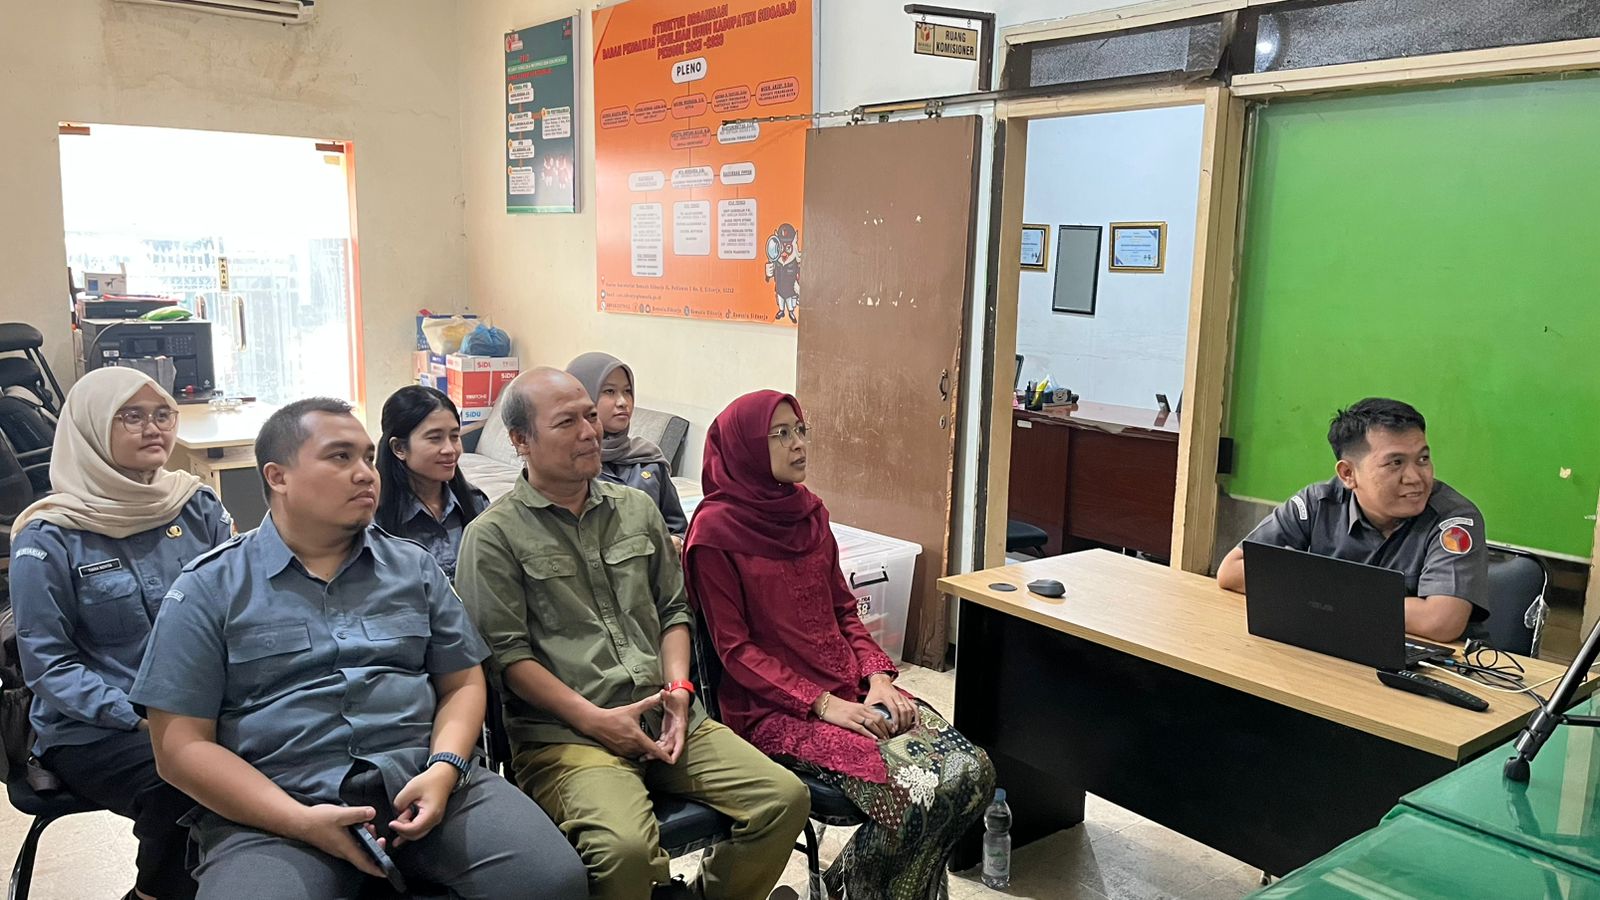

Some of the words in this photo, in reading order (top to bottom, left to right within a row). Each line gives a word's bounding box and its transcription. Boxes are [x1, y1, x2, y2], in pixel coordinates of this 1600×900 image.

[602, 44, 623, 60] BADAN
[623, 36, 656, 55] PENGAWAS
[712, 10, 756, 34] KABUPATEN
[757, 0, 797, 23] SIDOARJO
[652, 16, 686, 35] STRUKTUR
[687, 4, 729, 26] ORGANISASI
[945, 30, 966, 43] RUANG
[936, 41, 974, 56] KOMISIONER
[676, 62, 702, 76] PLENO
[219, 258, 228, 285] TARIK
